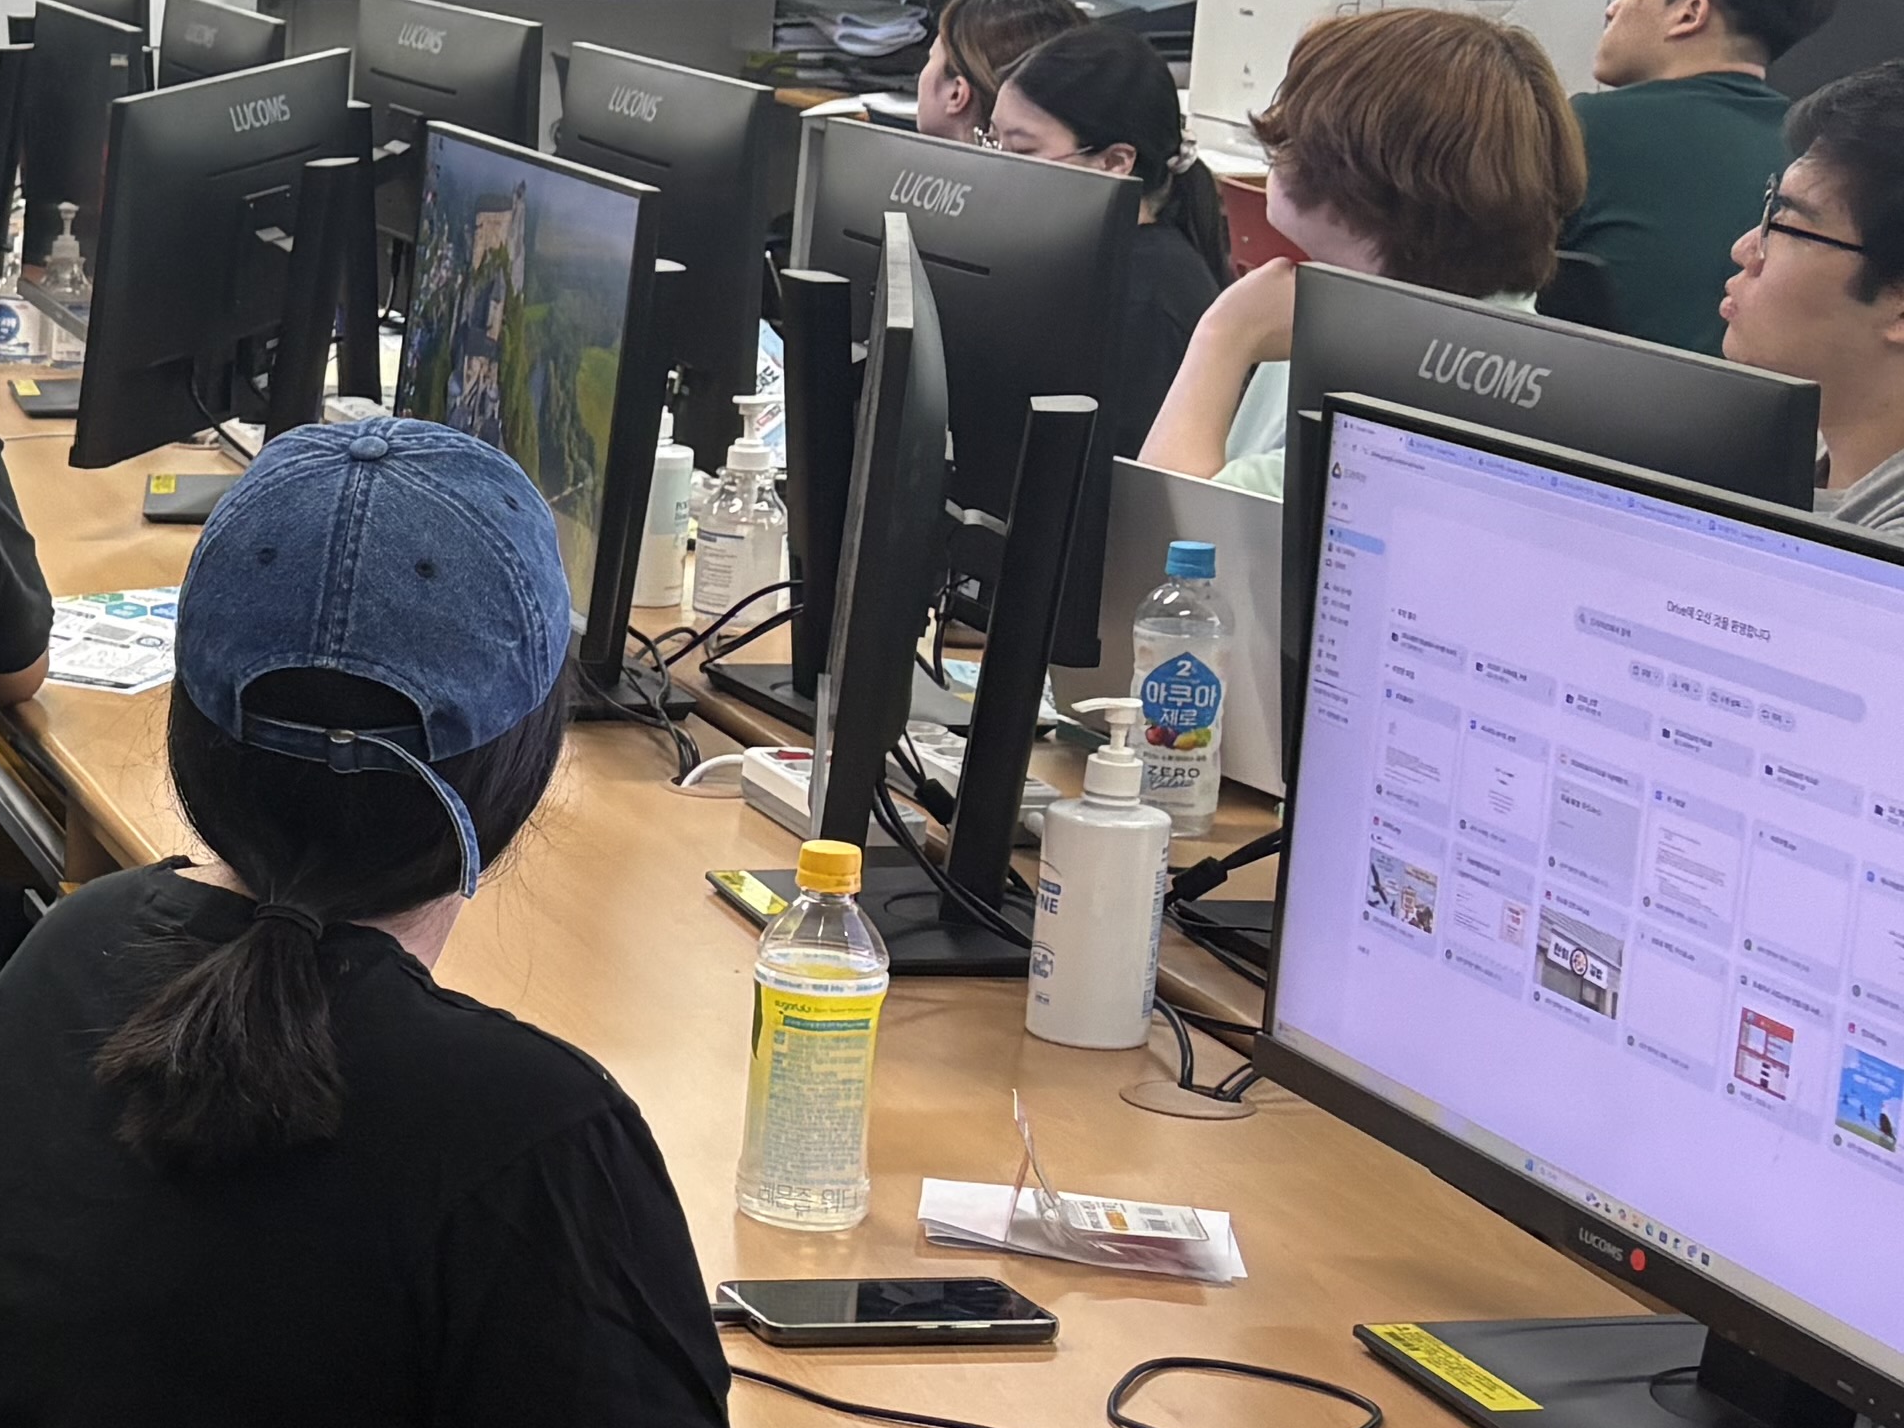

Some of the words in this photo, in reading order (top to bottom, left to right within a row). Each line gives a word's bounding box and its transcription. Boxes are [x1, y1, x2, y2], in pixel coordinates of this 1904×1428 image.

[397, 22, 449, 54] LUCOMS
[230, 94, 291, 133] LUCOMS
[607, 85, 665, 123] LUCOMS
[889, 169, 974, 216] LUCOMS
[1416, 337, 1552, 408] LUCOMS
[1146, 681, 1217, 708] 아쿠아
[1160, 708, 1198, 727] 제로
[1147, 765, 1201, 779] ZERO
[1578, 1225, 1624, 1262] LUCOMS
